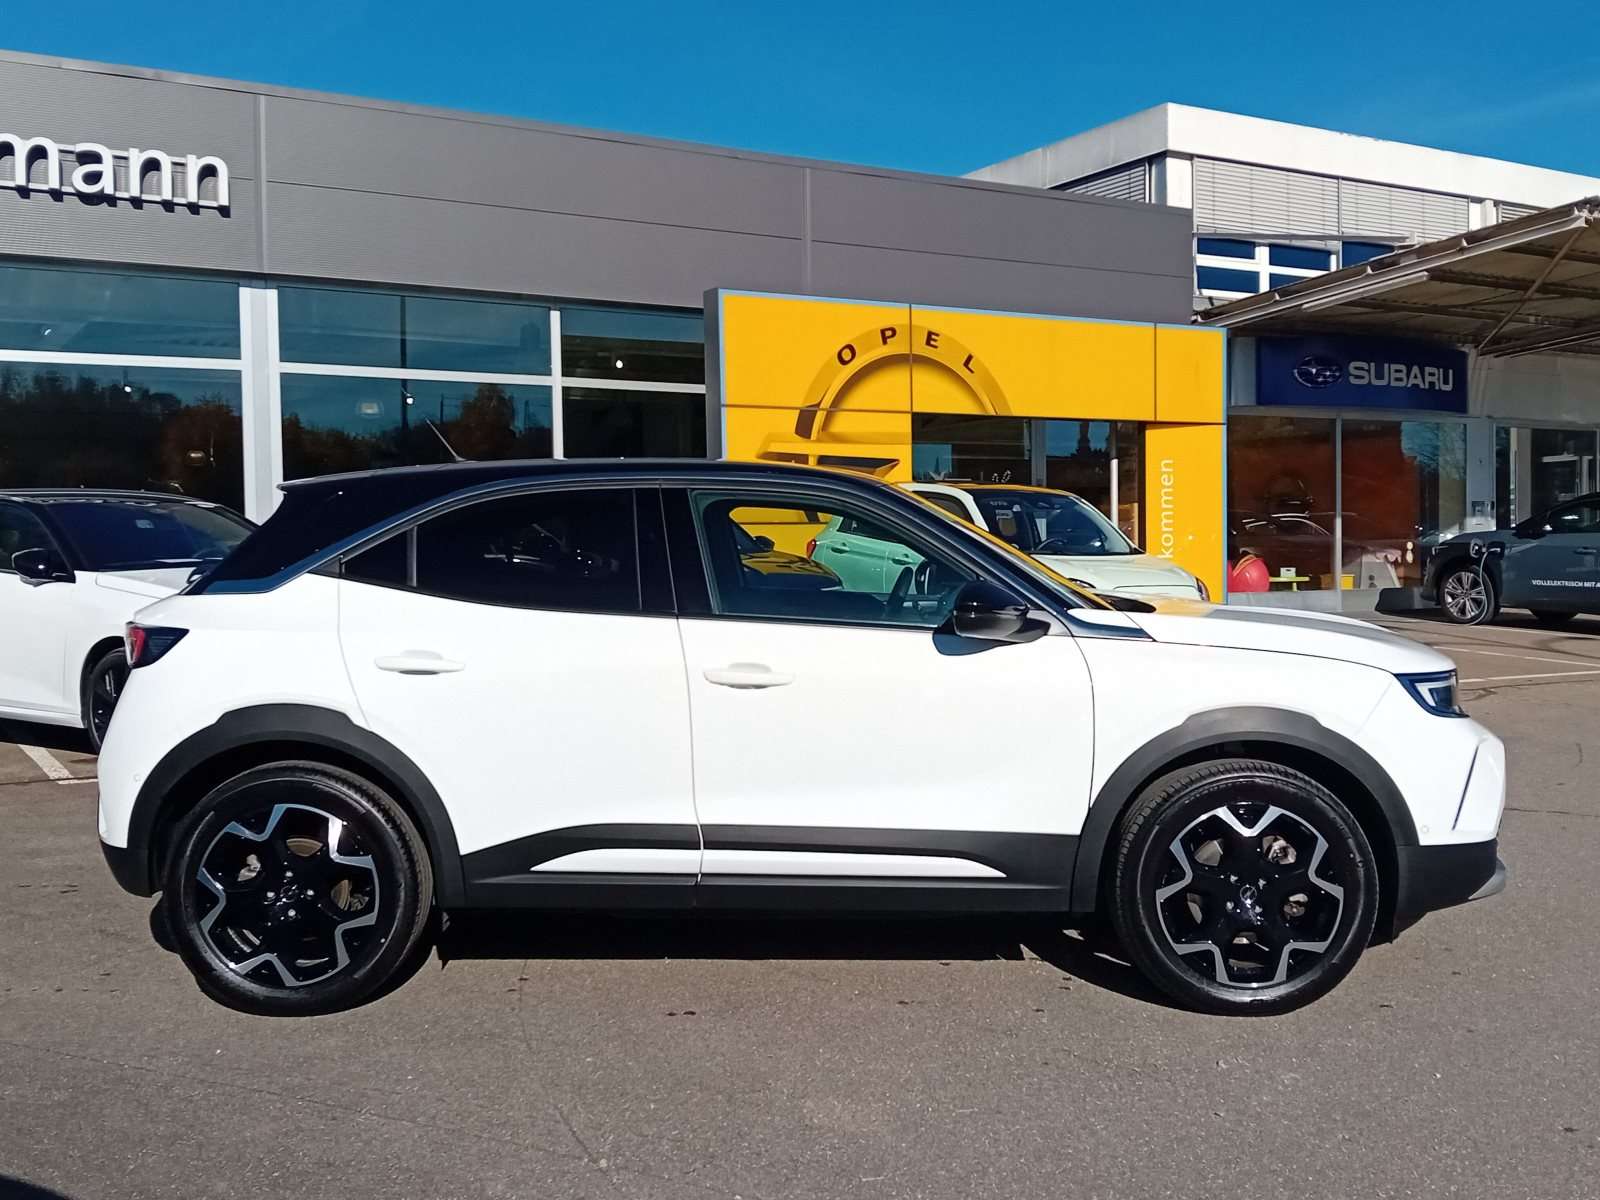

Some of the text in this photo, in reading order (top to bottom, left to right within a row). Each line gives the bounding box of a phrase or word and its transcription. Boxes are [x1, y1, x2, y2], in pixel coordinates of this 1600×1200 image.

[0, 133, 229, 206] mann
[837, 326, 975, 374] OPEL
[1349, 361, 1453, 391] SUBARU
